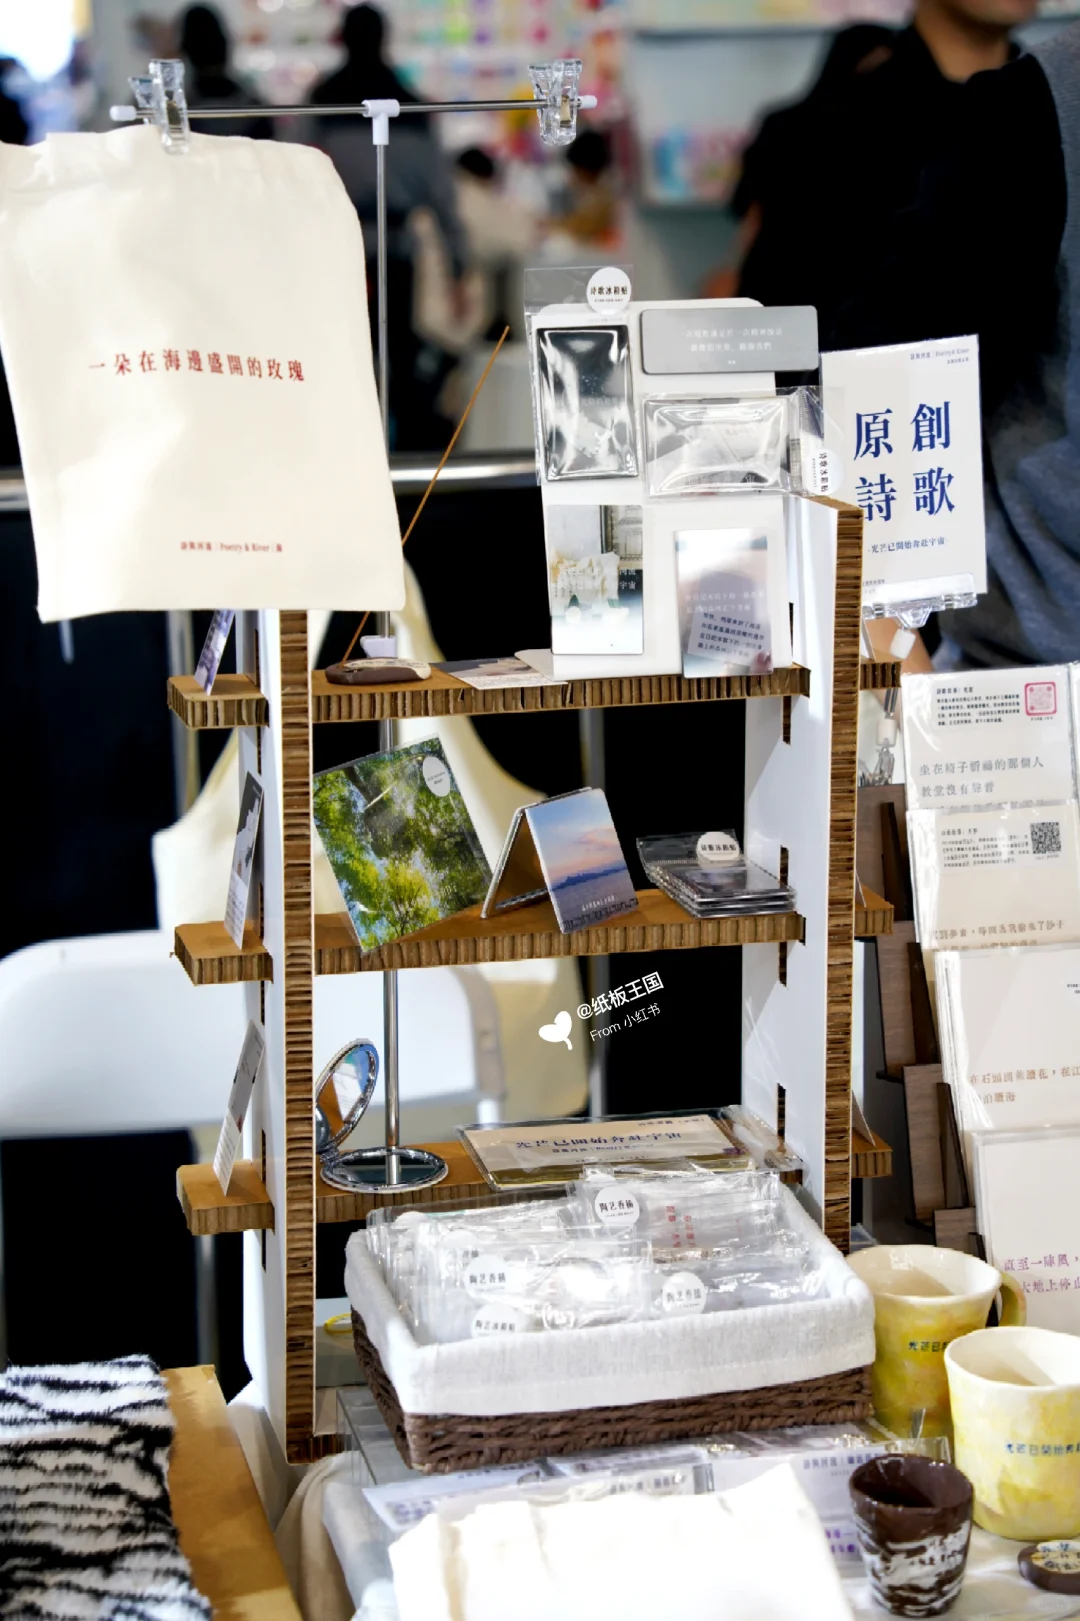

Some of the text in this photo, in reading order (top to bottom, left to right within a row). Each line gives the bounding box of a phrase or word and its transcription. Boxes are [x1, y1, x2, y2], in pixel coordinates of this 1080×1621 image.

[88, 349, 305, 381] 一朵在海邊盛開的玫瑰
[853, 401, 951, 461] 原創
[855, 467, 955, 522] 詩歌
